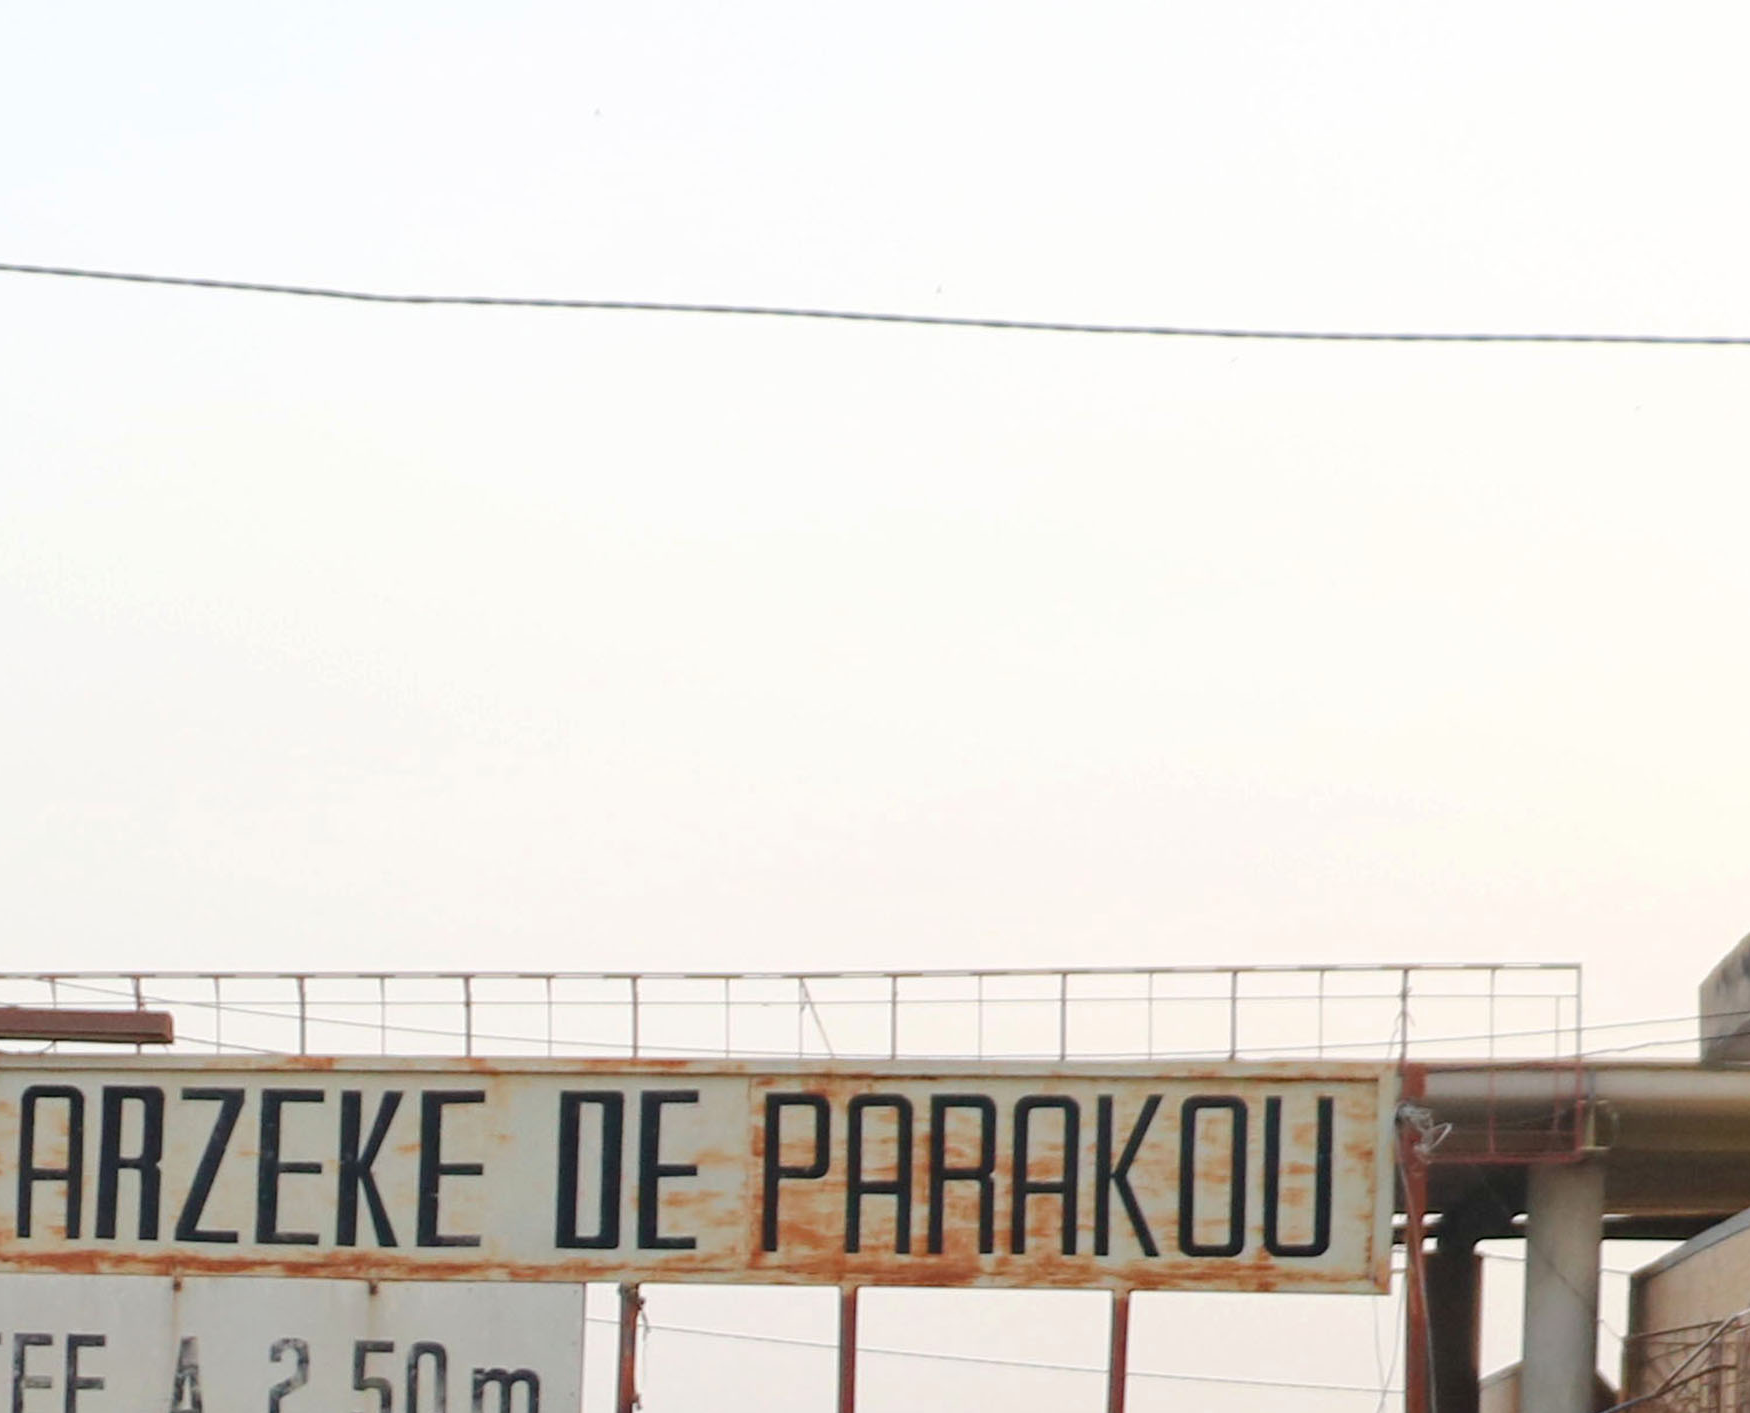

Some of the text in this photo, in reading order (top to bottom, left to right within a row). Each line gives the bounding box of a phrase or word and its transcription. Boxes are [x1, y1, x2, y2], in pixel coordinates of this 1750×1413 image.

[15, 1084, 488, 1248] ARZEKE
[554, 1088, 699, 1250] DE
[760, 1091, 1335, 1259] PARAKOU
